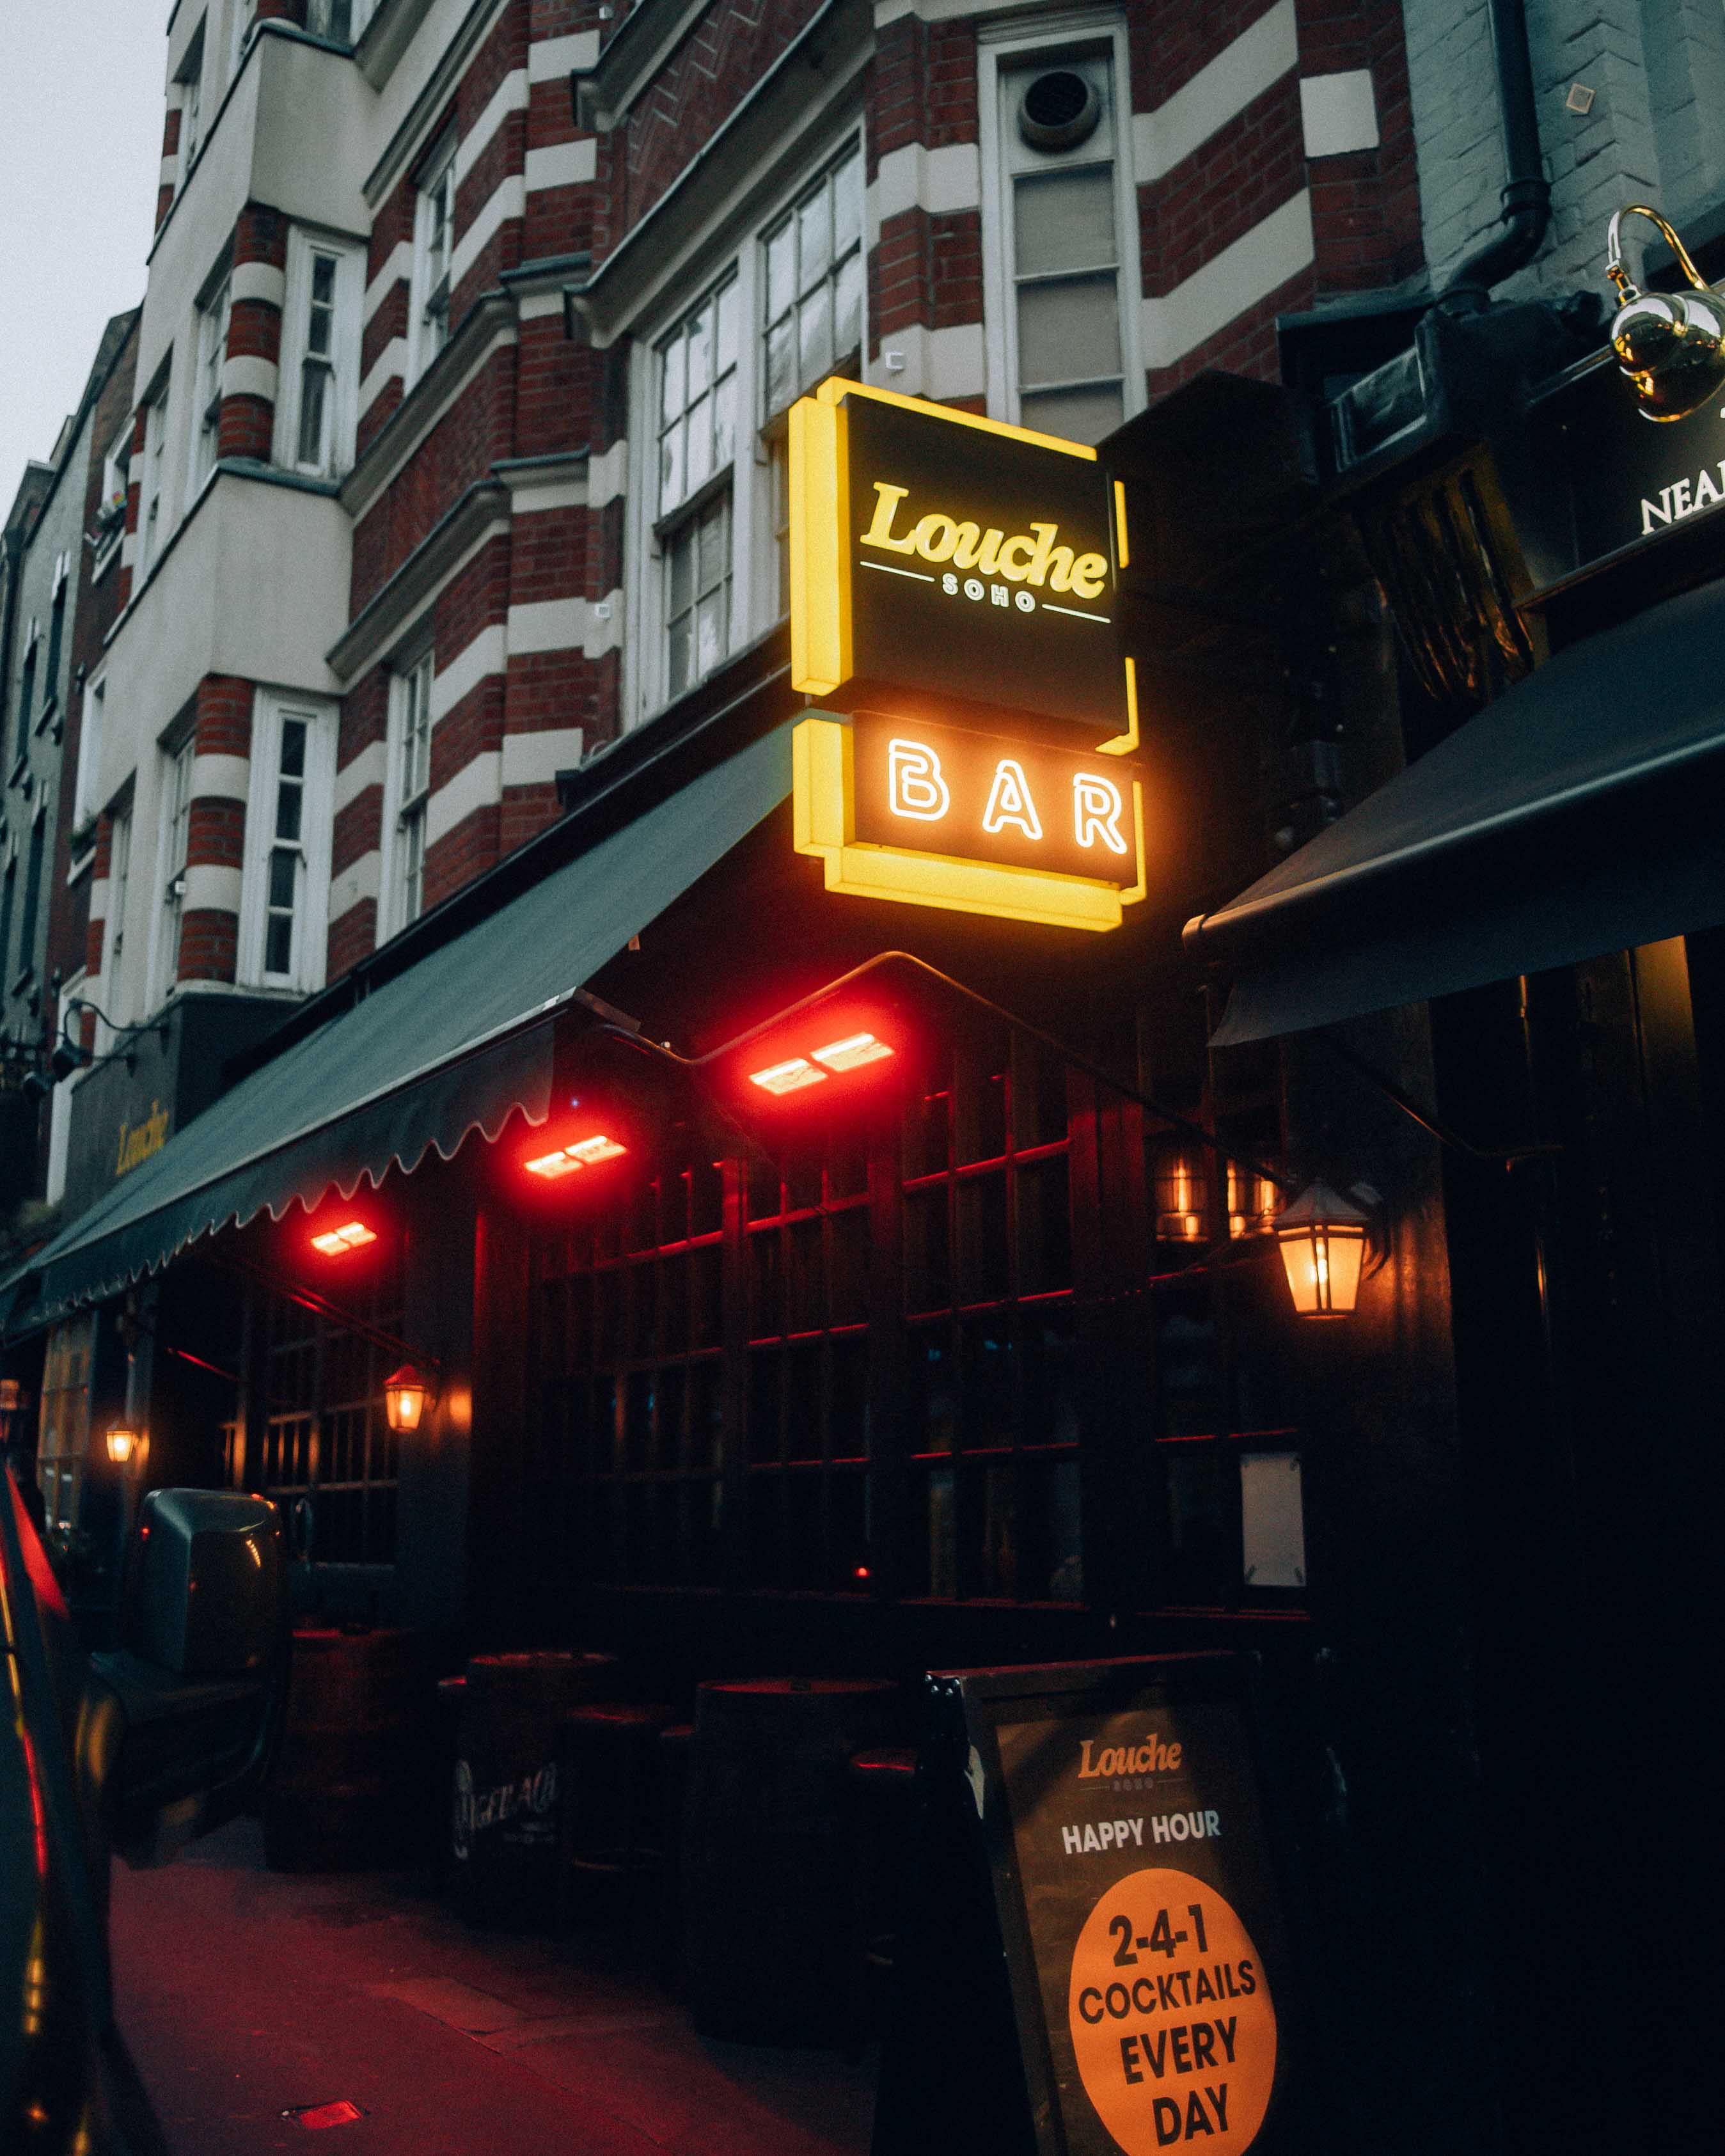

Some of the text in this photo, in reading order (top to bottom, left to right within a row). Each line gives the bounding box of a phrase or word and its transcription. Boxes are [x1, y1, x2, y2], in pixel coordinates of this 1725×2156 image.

[859, 481, 1108, 599] Louche
[941, 571, 1036, 613] SOHO
[887, 737, 1128, 855] BAR
[1078, 1733, 1183, 1779] Louche
[1062, 1810, 1223, 1855] HAPPY HOUR
[1108, 1903, 1209, 1967] 2-4-1
[1078, 1959, 1256, 2024] COCKTAILS
[1119, 2016, 1238, 2085] EVERY
[1152, 2083, 1228, 2148] DAY
